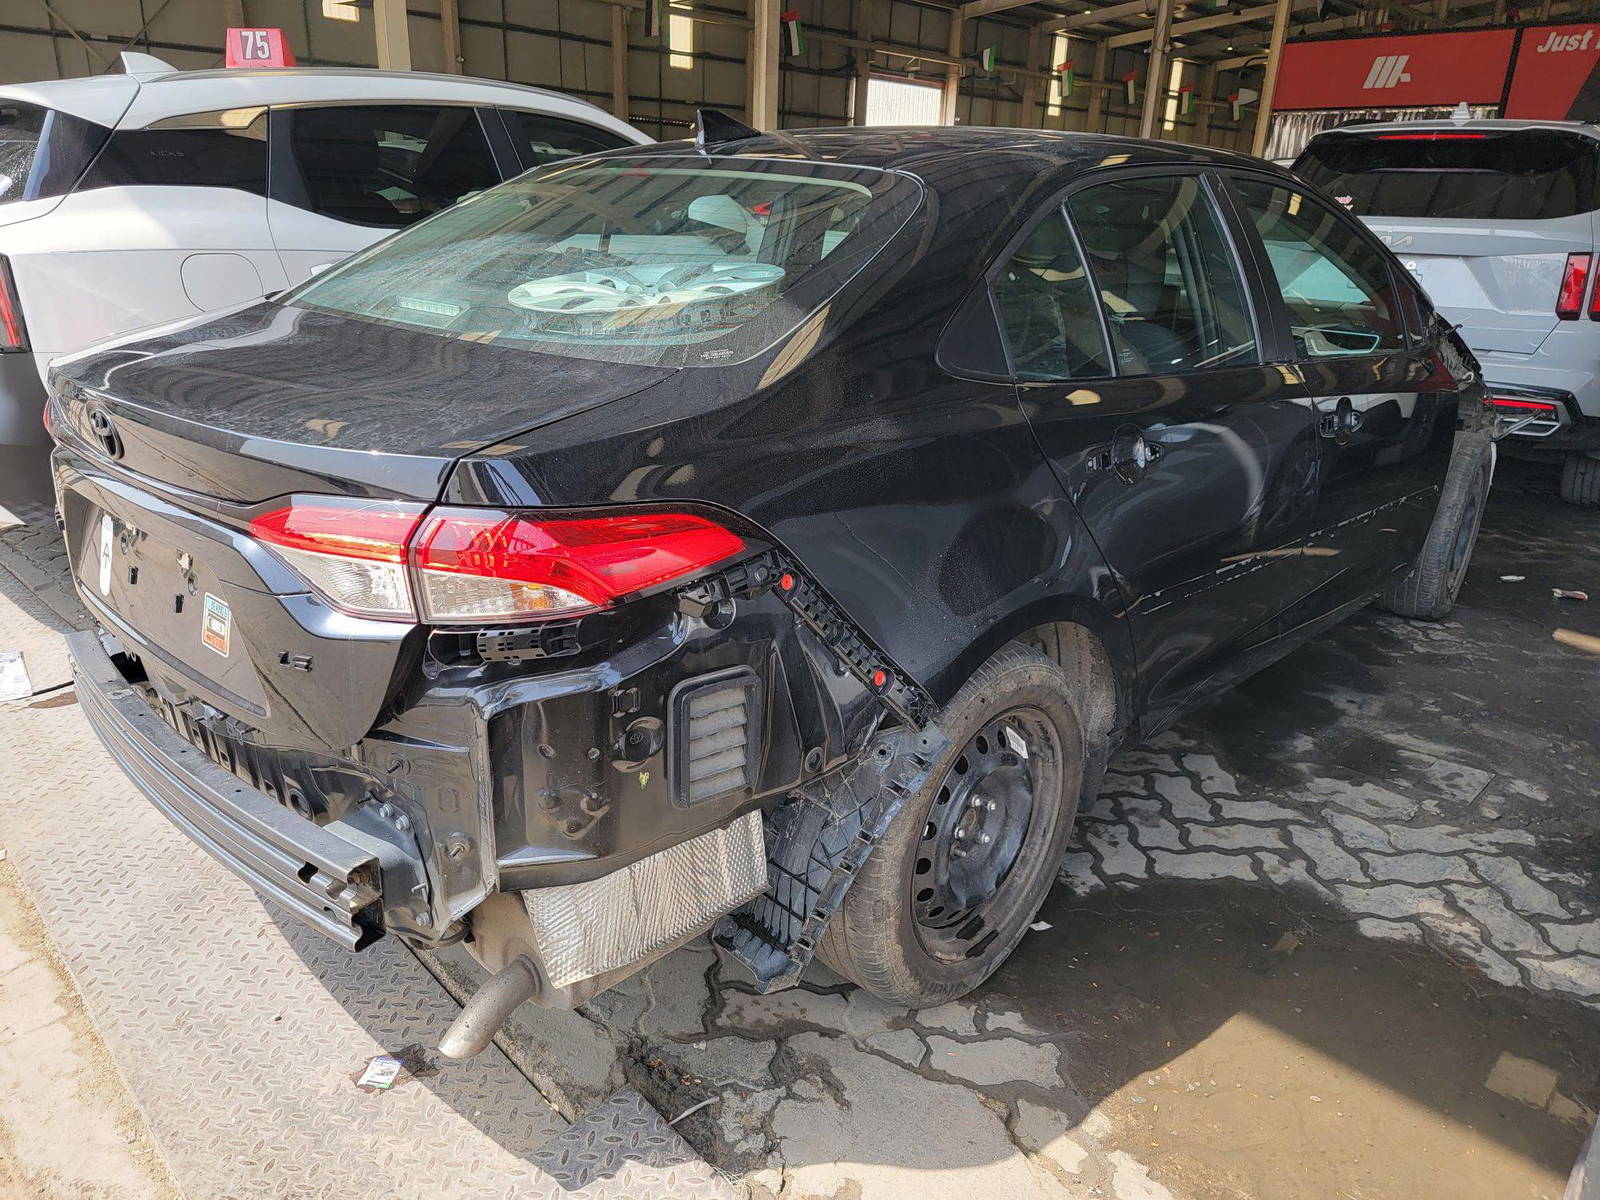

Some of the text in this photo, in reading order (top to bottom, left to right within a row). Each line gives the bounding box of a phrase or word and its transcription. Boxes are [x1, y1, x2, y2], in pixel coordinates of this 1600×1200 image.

[241, 31, 270, 59] 75
[1537, 30, 1593, 53] Just
[277, 649, 314, 672] LE
